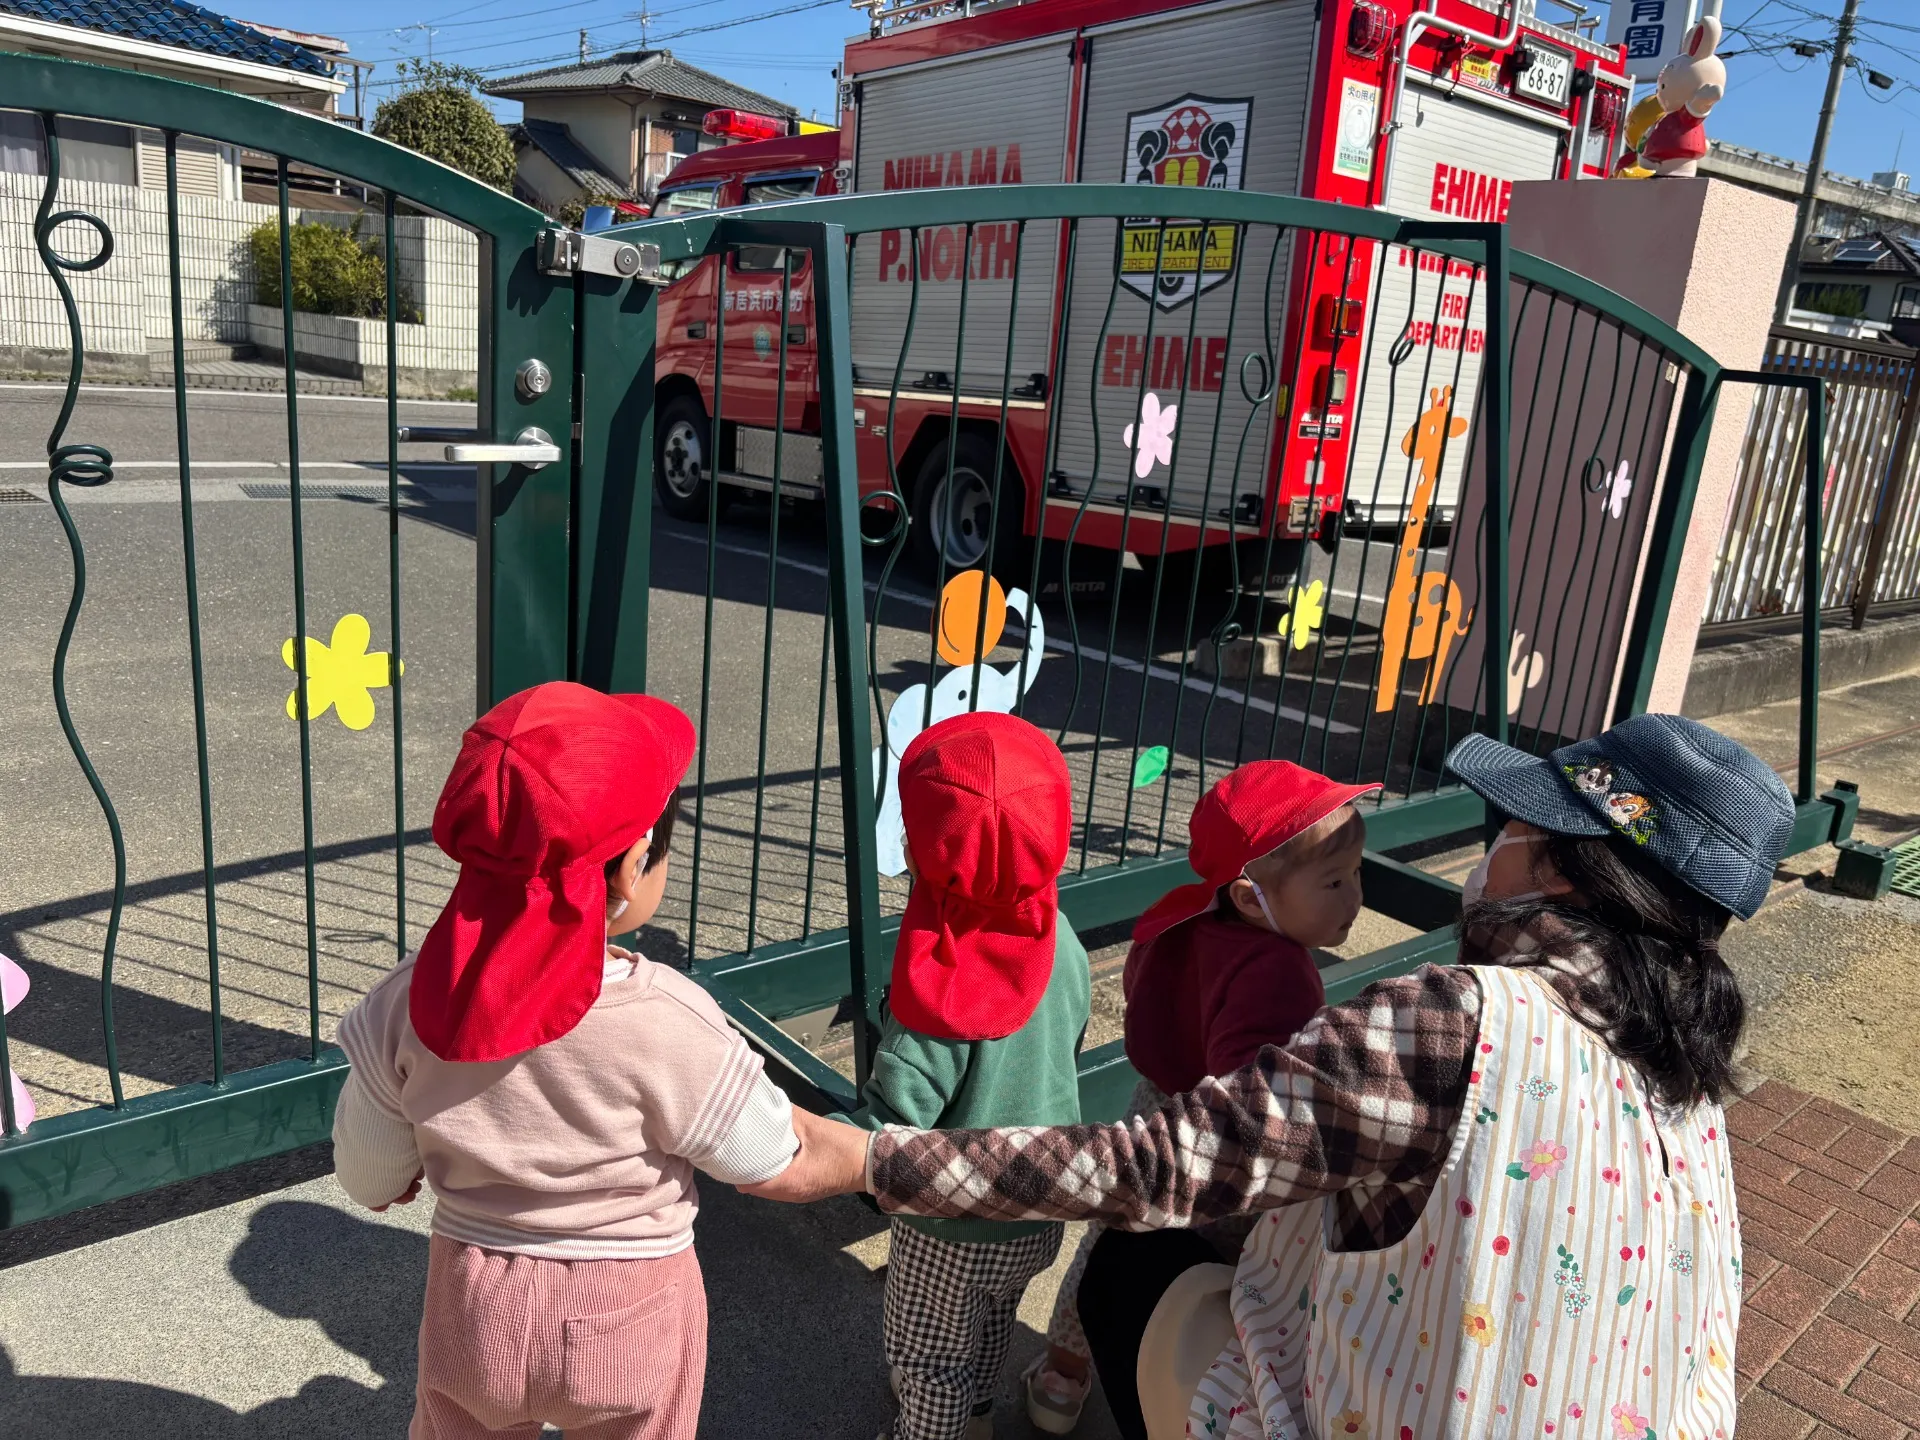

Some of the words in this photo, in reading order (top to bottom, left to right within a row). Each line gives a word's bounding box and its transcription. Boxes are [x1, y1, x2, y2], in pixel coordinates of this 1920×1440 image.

[1430, 162, 1512, 223] EHIME
[1132, 230, 1217, 252] NIIHAMA
[1147, 256, 1229, 269] DPARTMENT
[1101, 336, 1227, 392] EHIME
